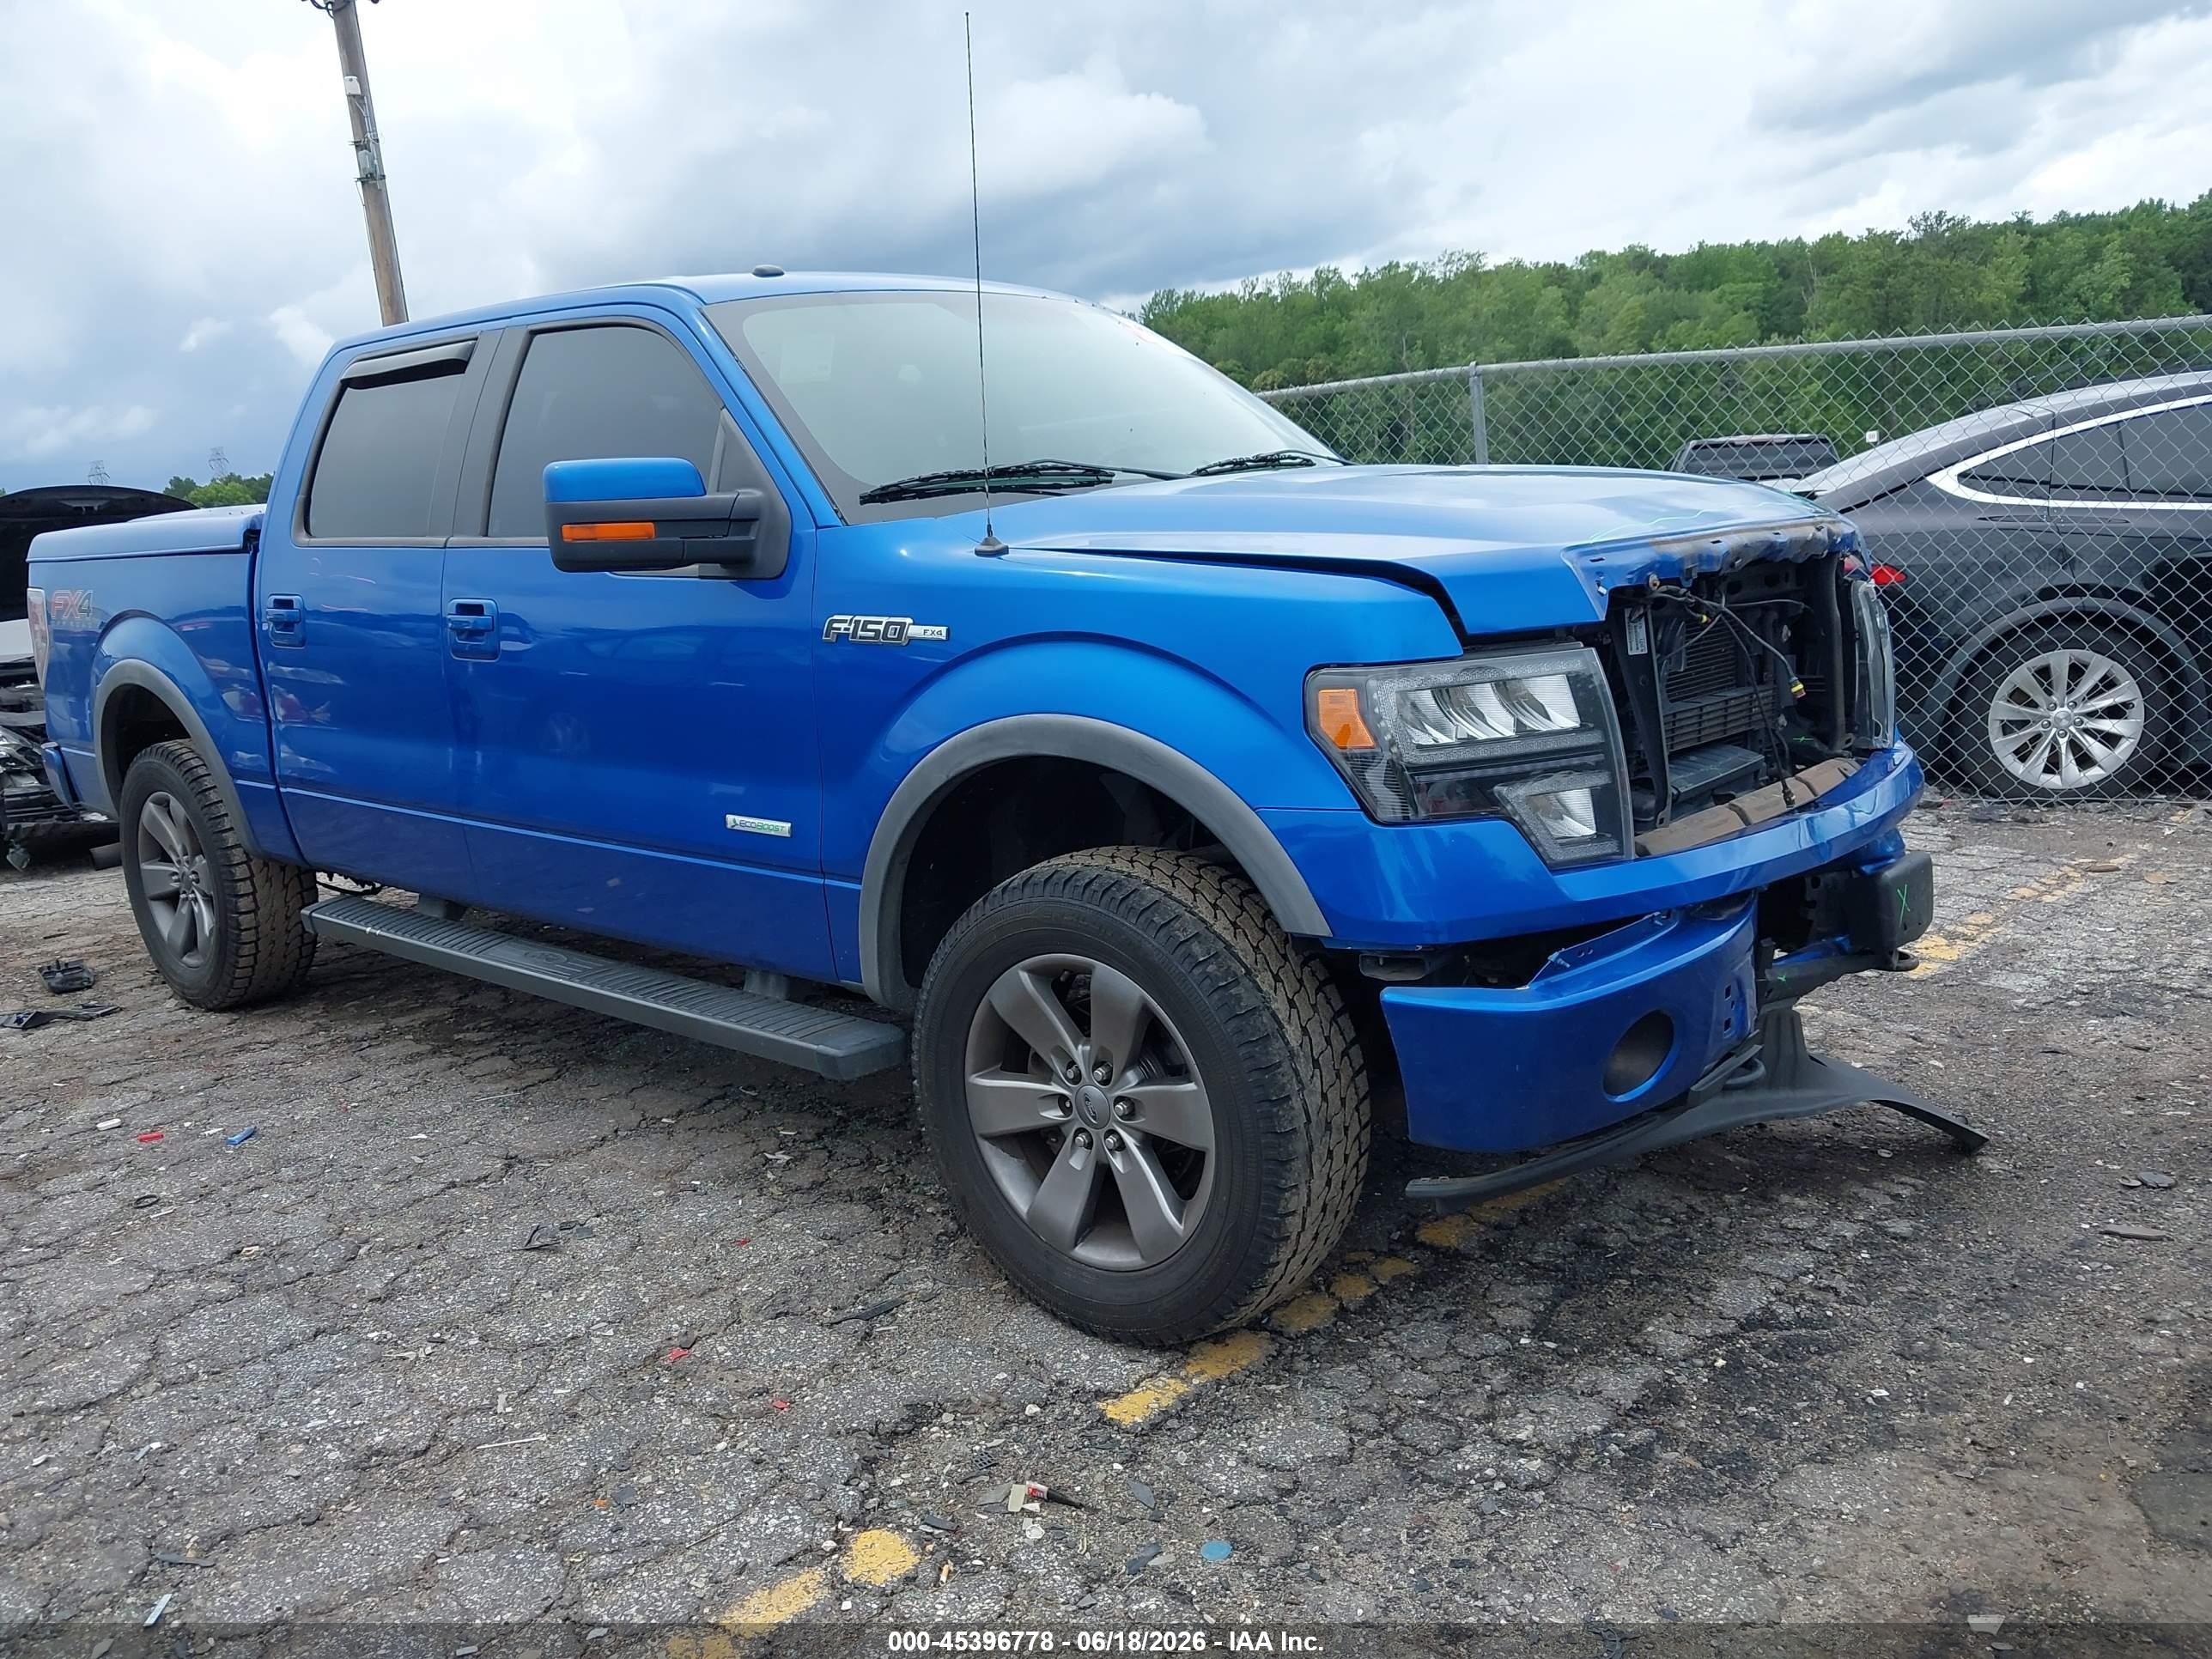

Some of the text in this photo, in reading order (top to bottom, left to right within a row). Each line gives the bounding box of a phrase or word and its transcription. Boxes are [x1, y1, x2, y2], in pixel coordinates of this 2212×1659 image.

[51, 589, 94, 618] FX4
[823, 615, 913, 646] F-150
[738, 819, 786, 832] ECOBOOST
